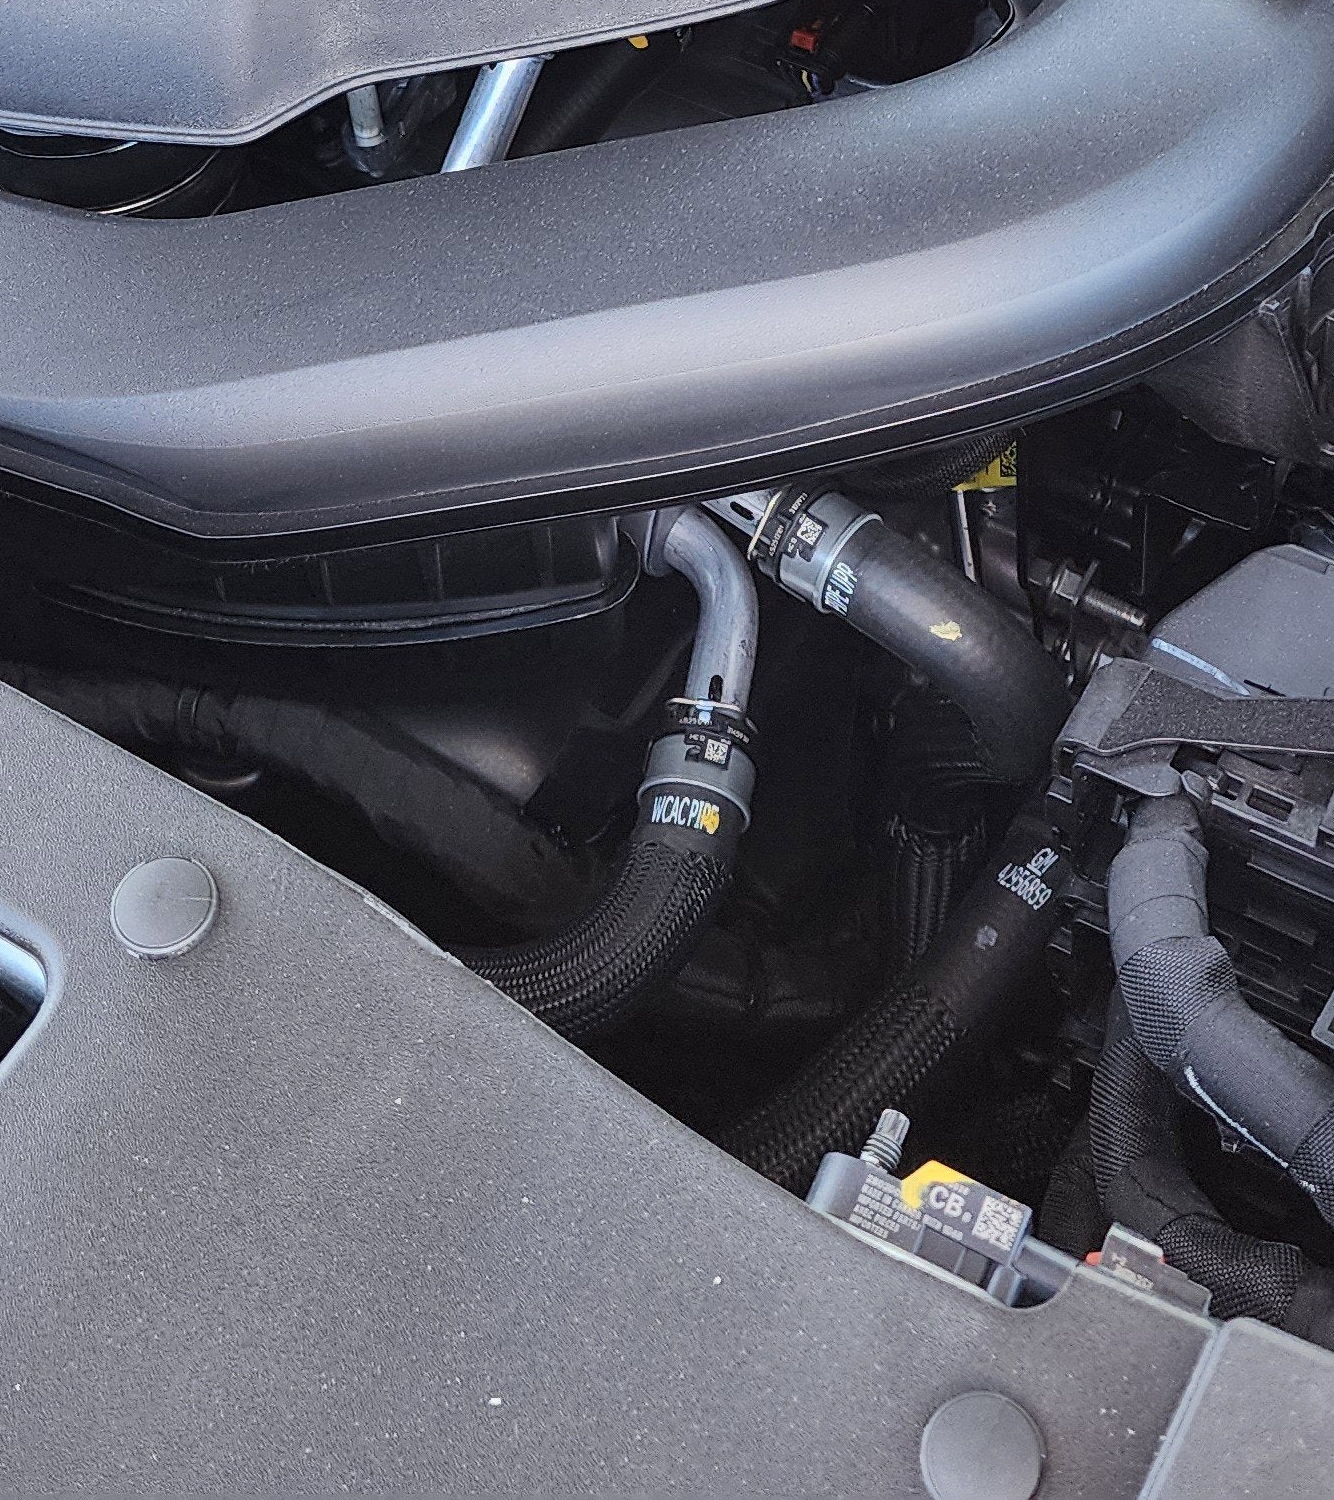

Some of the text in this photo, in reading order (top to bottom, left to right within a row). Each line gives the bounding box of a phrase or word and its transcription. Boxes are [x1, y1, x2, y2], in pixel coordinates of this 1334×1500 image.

[830, 562, 857, 595] UPR
[1031, 848, 1059, 873] GM
[998, 863, 1052, 910] 42956859
